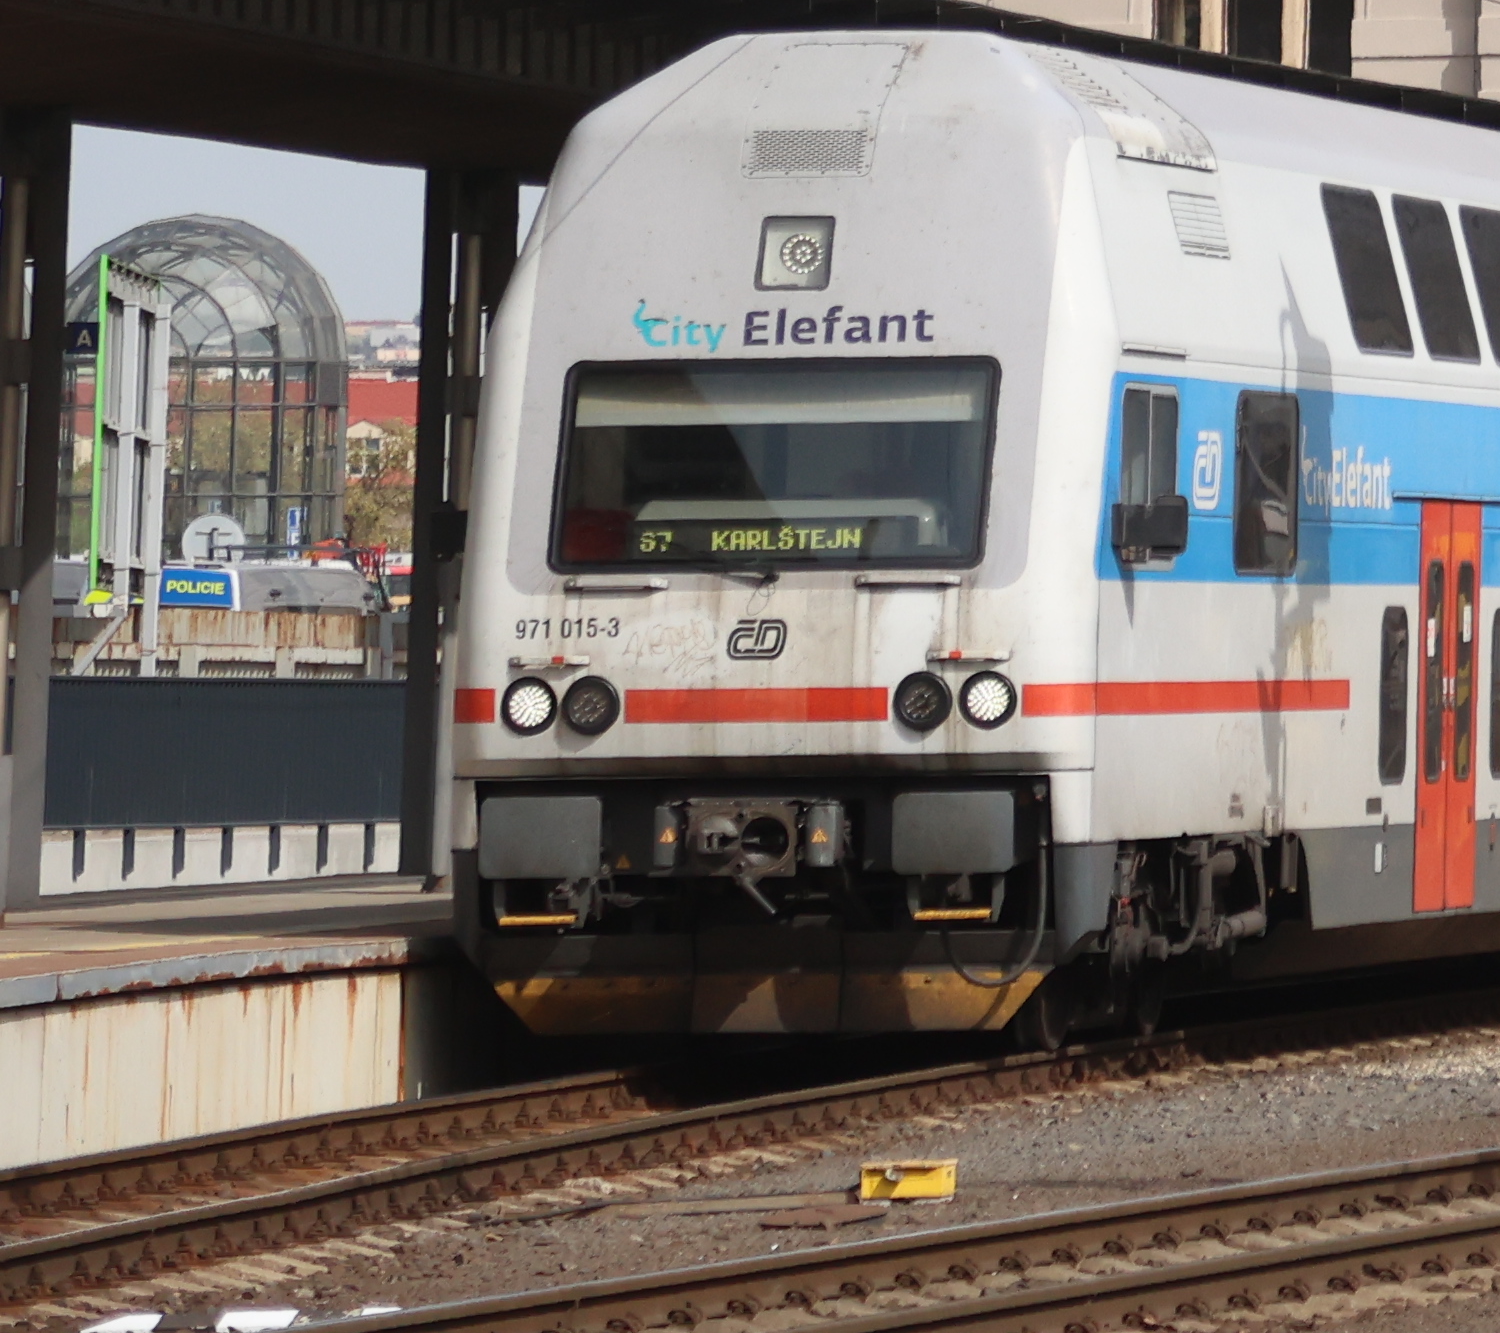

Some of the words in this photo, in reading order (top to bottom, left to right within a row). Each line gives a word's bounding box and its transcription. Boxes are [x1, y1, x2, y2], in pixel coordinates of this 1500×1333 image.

[77, 329, 92, 347] A
[635, 306, 727, 353] City
[743, 306, 935, 347] Elefant
[1331, 445, 1391, 510] Elefant
[639, 531, 674, 553] S7
[711, 525, 862, 552] KARLŠTEJN
[166, 579, 225, 596] POLICIE
[515, 618, 551, 640] 971
[560, 617, 621, 639] 015-3
